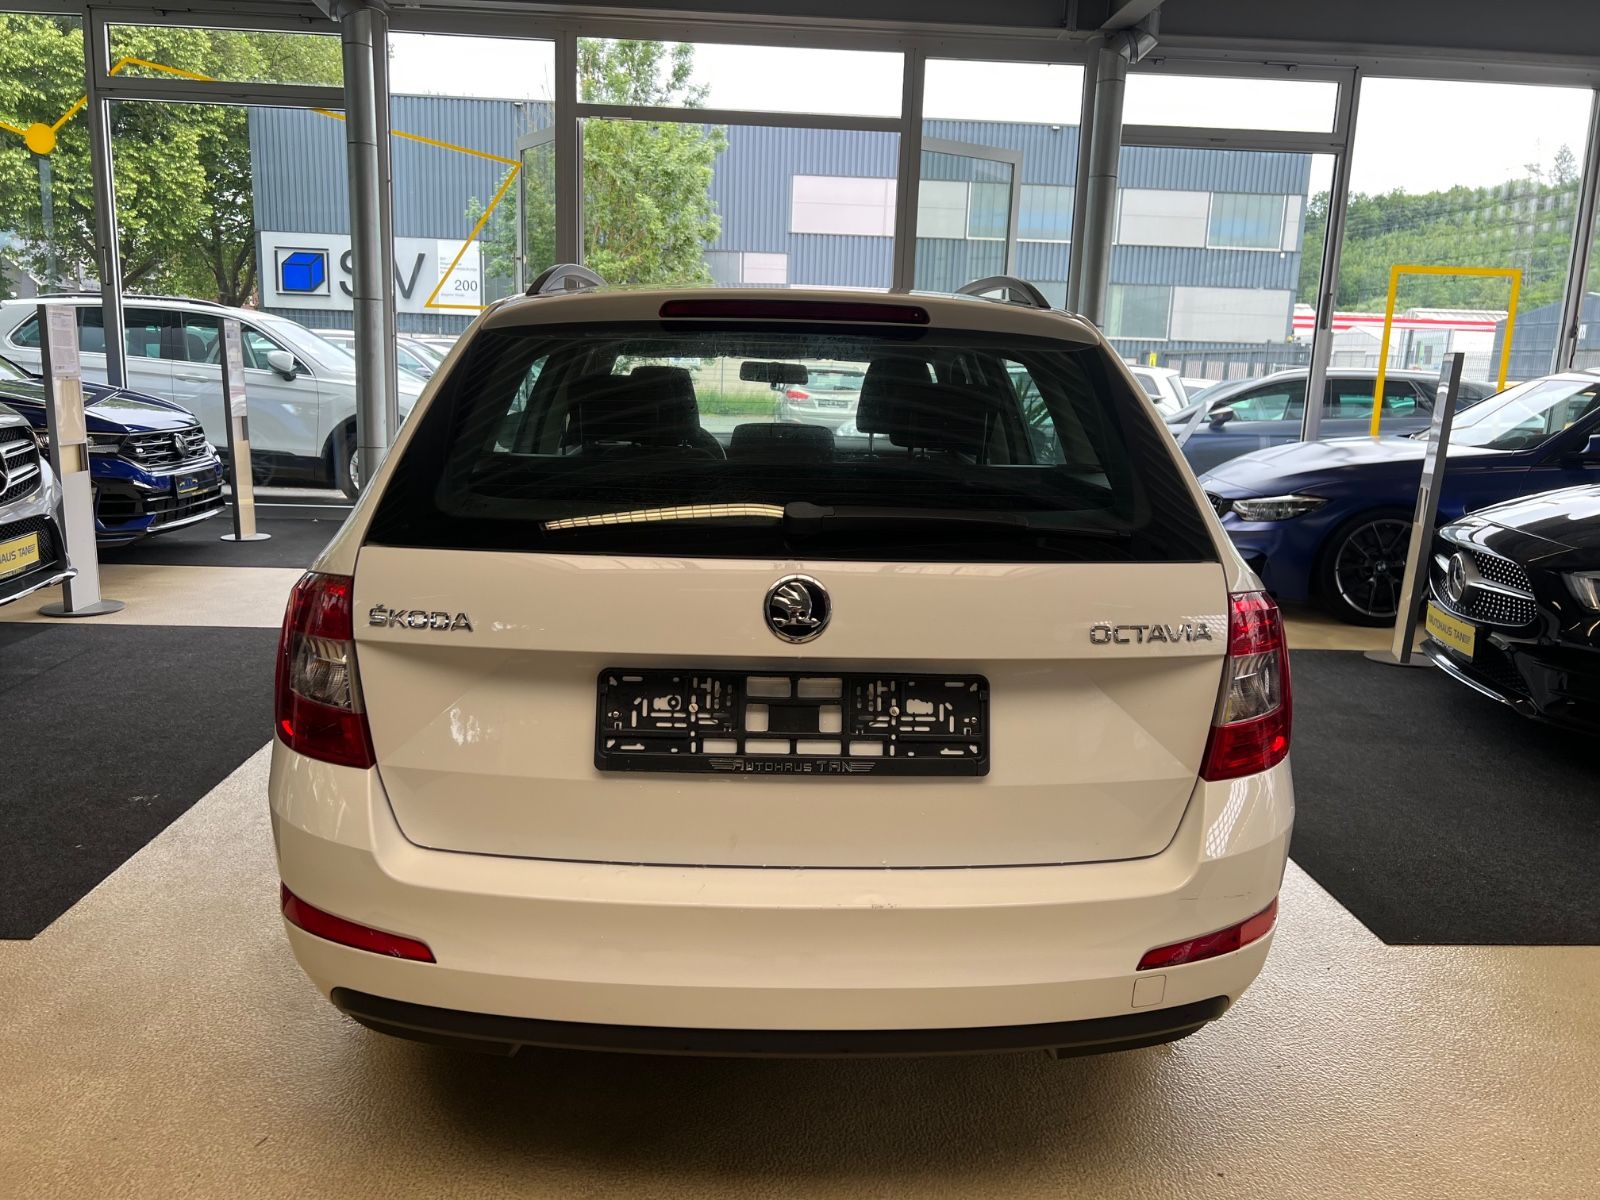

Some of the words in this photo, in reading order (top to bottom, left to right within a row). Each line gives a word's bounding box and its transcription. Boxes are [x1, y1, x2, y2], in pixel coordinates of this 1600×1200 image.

[339, 248, 426, 299] SV
[454, 279, 478, 292] 200
[0, 550, 17, 565] AUS
[369, 603, 474, 632] ŠKODA
[1089, 623, 1213, 645] OCTAVIA
[732, 759, 813, 773] AUTOHAUS
[816, 760, 852, 773] TAN
